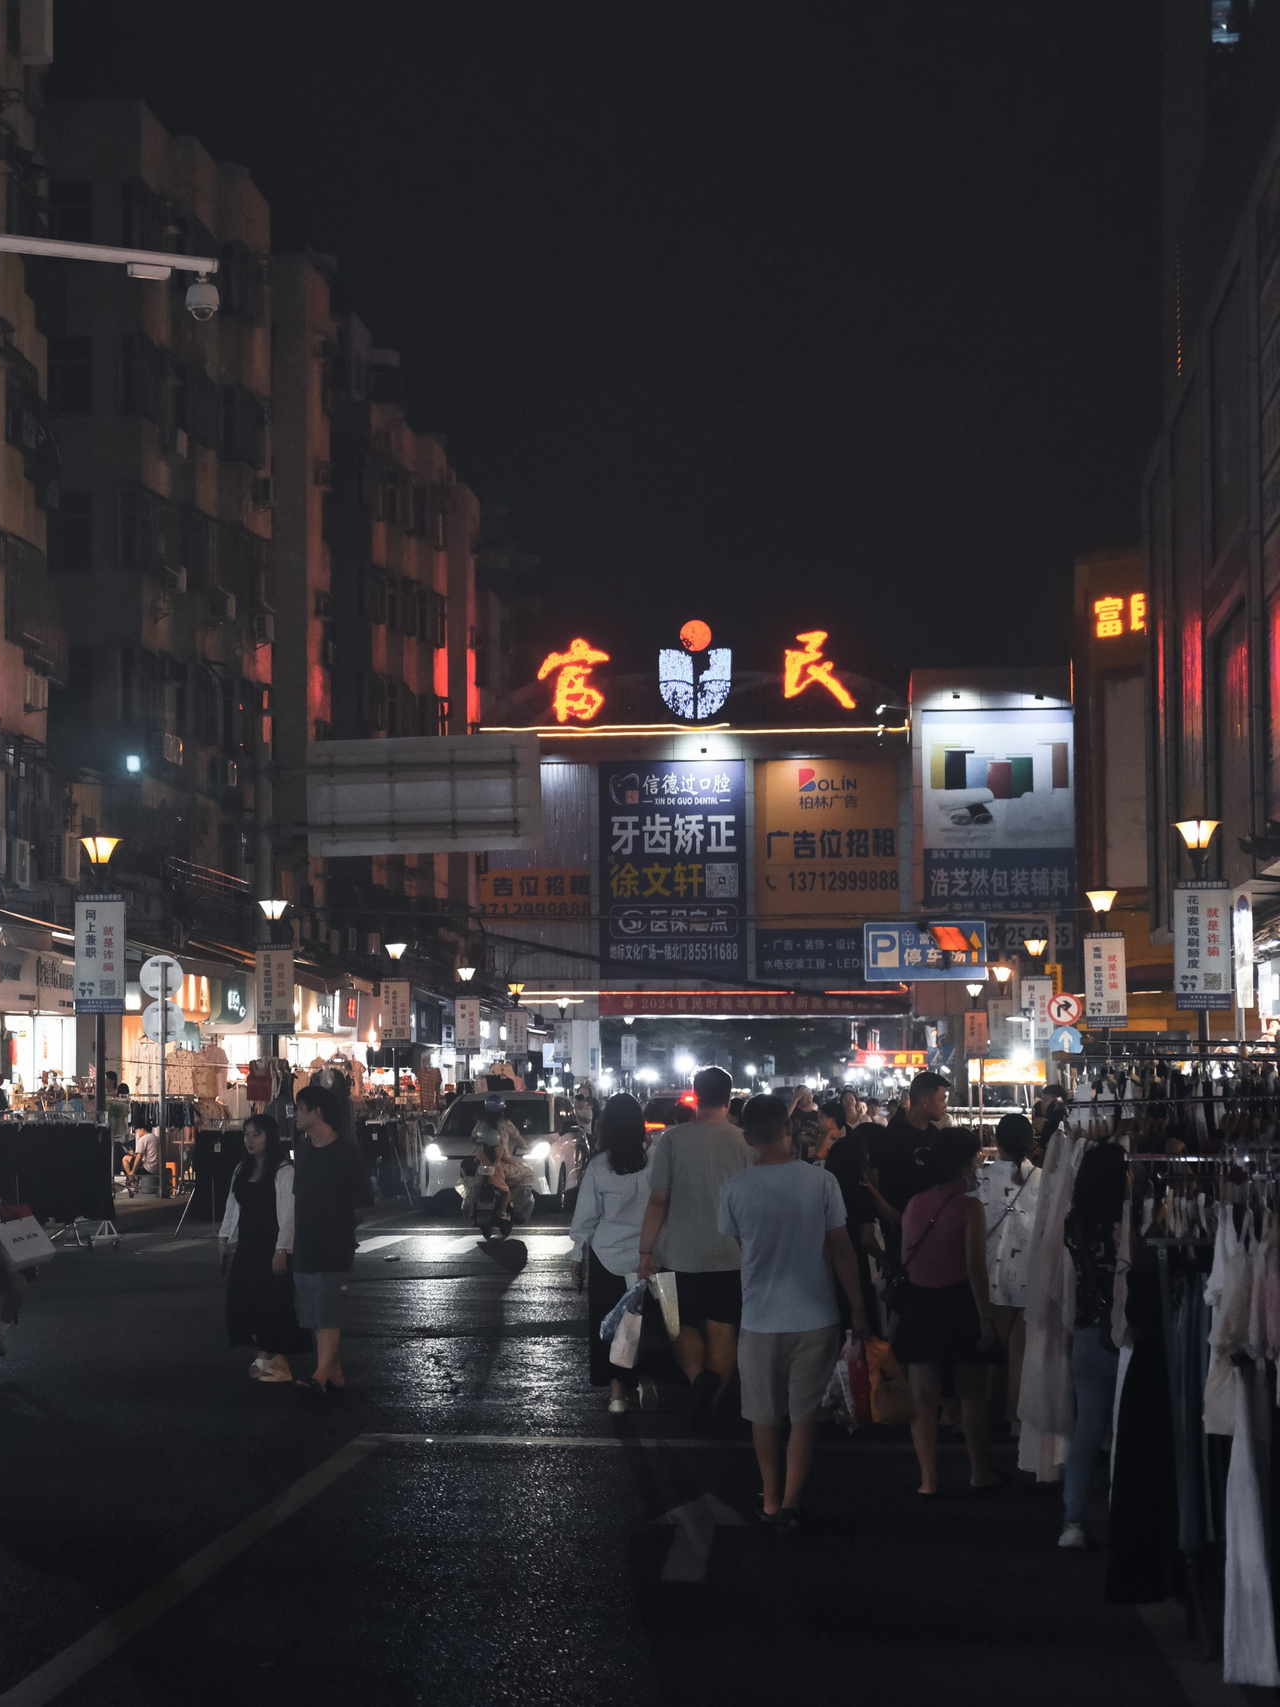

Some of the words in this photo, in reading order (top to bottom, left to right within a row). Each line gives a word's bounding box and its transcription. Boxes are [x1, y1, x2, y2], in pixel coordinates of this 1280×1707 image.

[537, 638, 610, 723] 富
[784, 630, 856, 710] 民
[642, 772, 731, 795] 信德过口腔
[667, 797, 676, 805] DE
[677, 797, 693, 805] GUO
[694, 797, 718, 805] DENTAL
[798, 795, 857, 809] 柏林广告
[610, 813, 737, 855] 牙齿矫正
[767, 828, 896, 860] 广告位招租
[481, 875, 591, 897] 告位招租
[610, 862, 704, 898] 徐文轩
[788, 870, 898, 892] 13712999888
[930, 867, 1070, 896] 浩芝然包装辅料
[85, 909, 97, 958] 网上兼职
[773, 939, 793, 951] 广告
[804, 939, 825, 951] 装饰
[836, 938, 857, 951] 设计
[1187, 895, 1200, 969] 花呗套现刷额度
[1206, 907, 1220, 957] 就是诈骗
[102, 926, 114, 973] 就是诈骗
[764, 958, 826, 970] 水电安装工程
[1107, 954, 1118, 990] 就是诈骗
[26, 1232, 38, 1240] JUN
